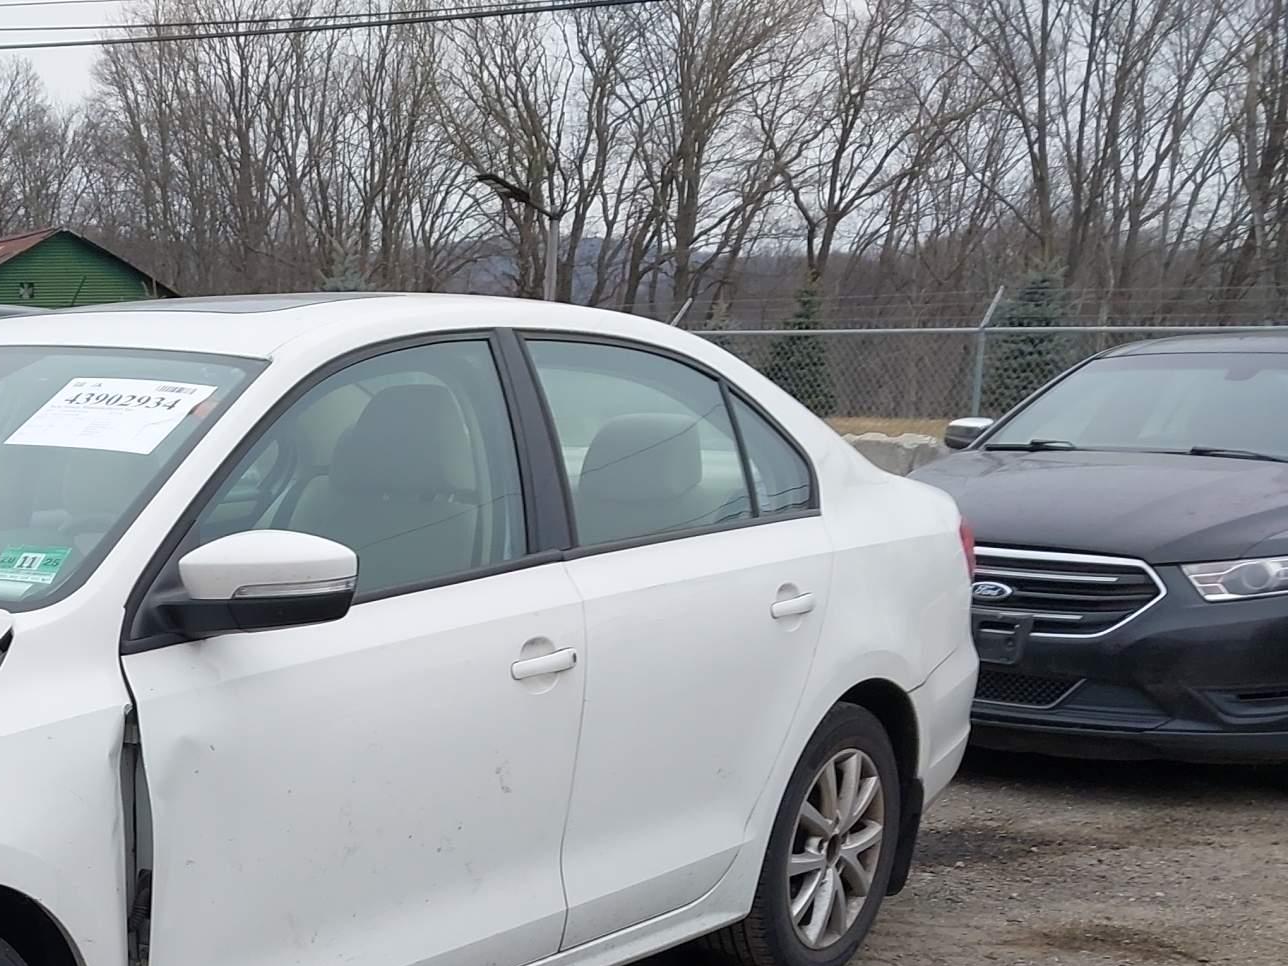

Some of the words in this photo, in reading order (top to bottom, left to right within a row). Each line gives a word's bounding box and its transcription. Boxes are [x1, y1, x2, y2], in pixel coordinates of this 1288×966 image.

[64, 392, 182, 410] 43902934
[17, 555, 38, 569] 11
[42, 559, 62, 567] 25
[974, 585, 1001, 597] Ford
